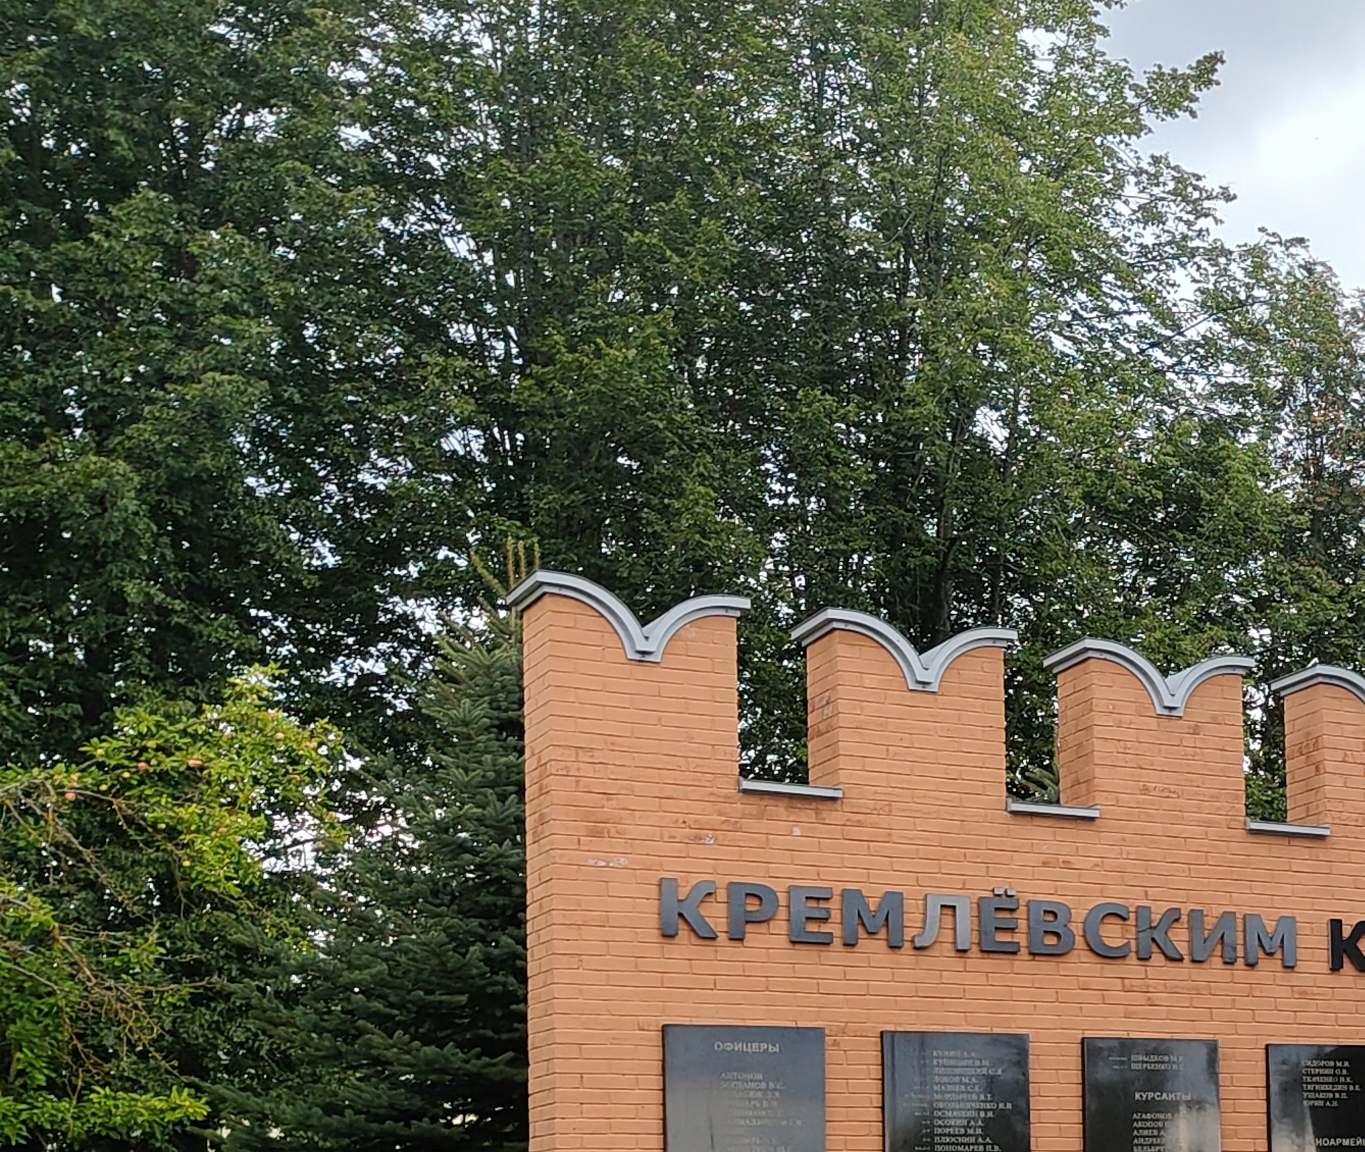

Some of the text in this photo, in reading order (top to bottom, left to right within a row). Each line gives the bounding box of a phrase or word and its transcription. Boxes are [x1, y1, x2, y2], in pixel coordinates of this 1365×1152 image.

[660, 876, 1297, 968] КРЕМЛЁВСКИМ
[714, 1041, 780, 1053] ОФИЦЕРЫ
[1134, 1092, 1192, 1101] КУРСАНТЫ
